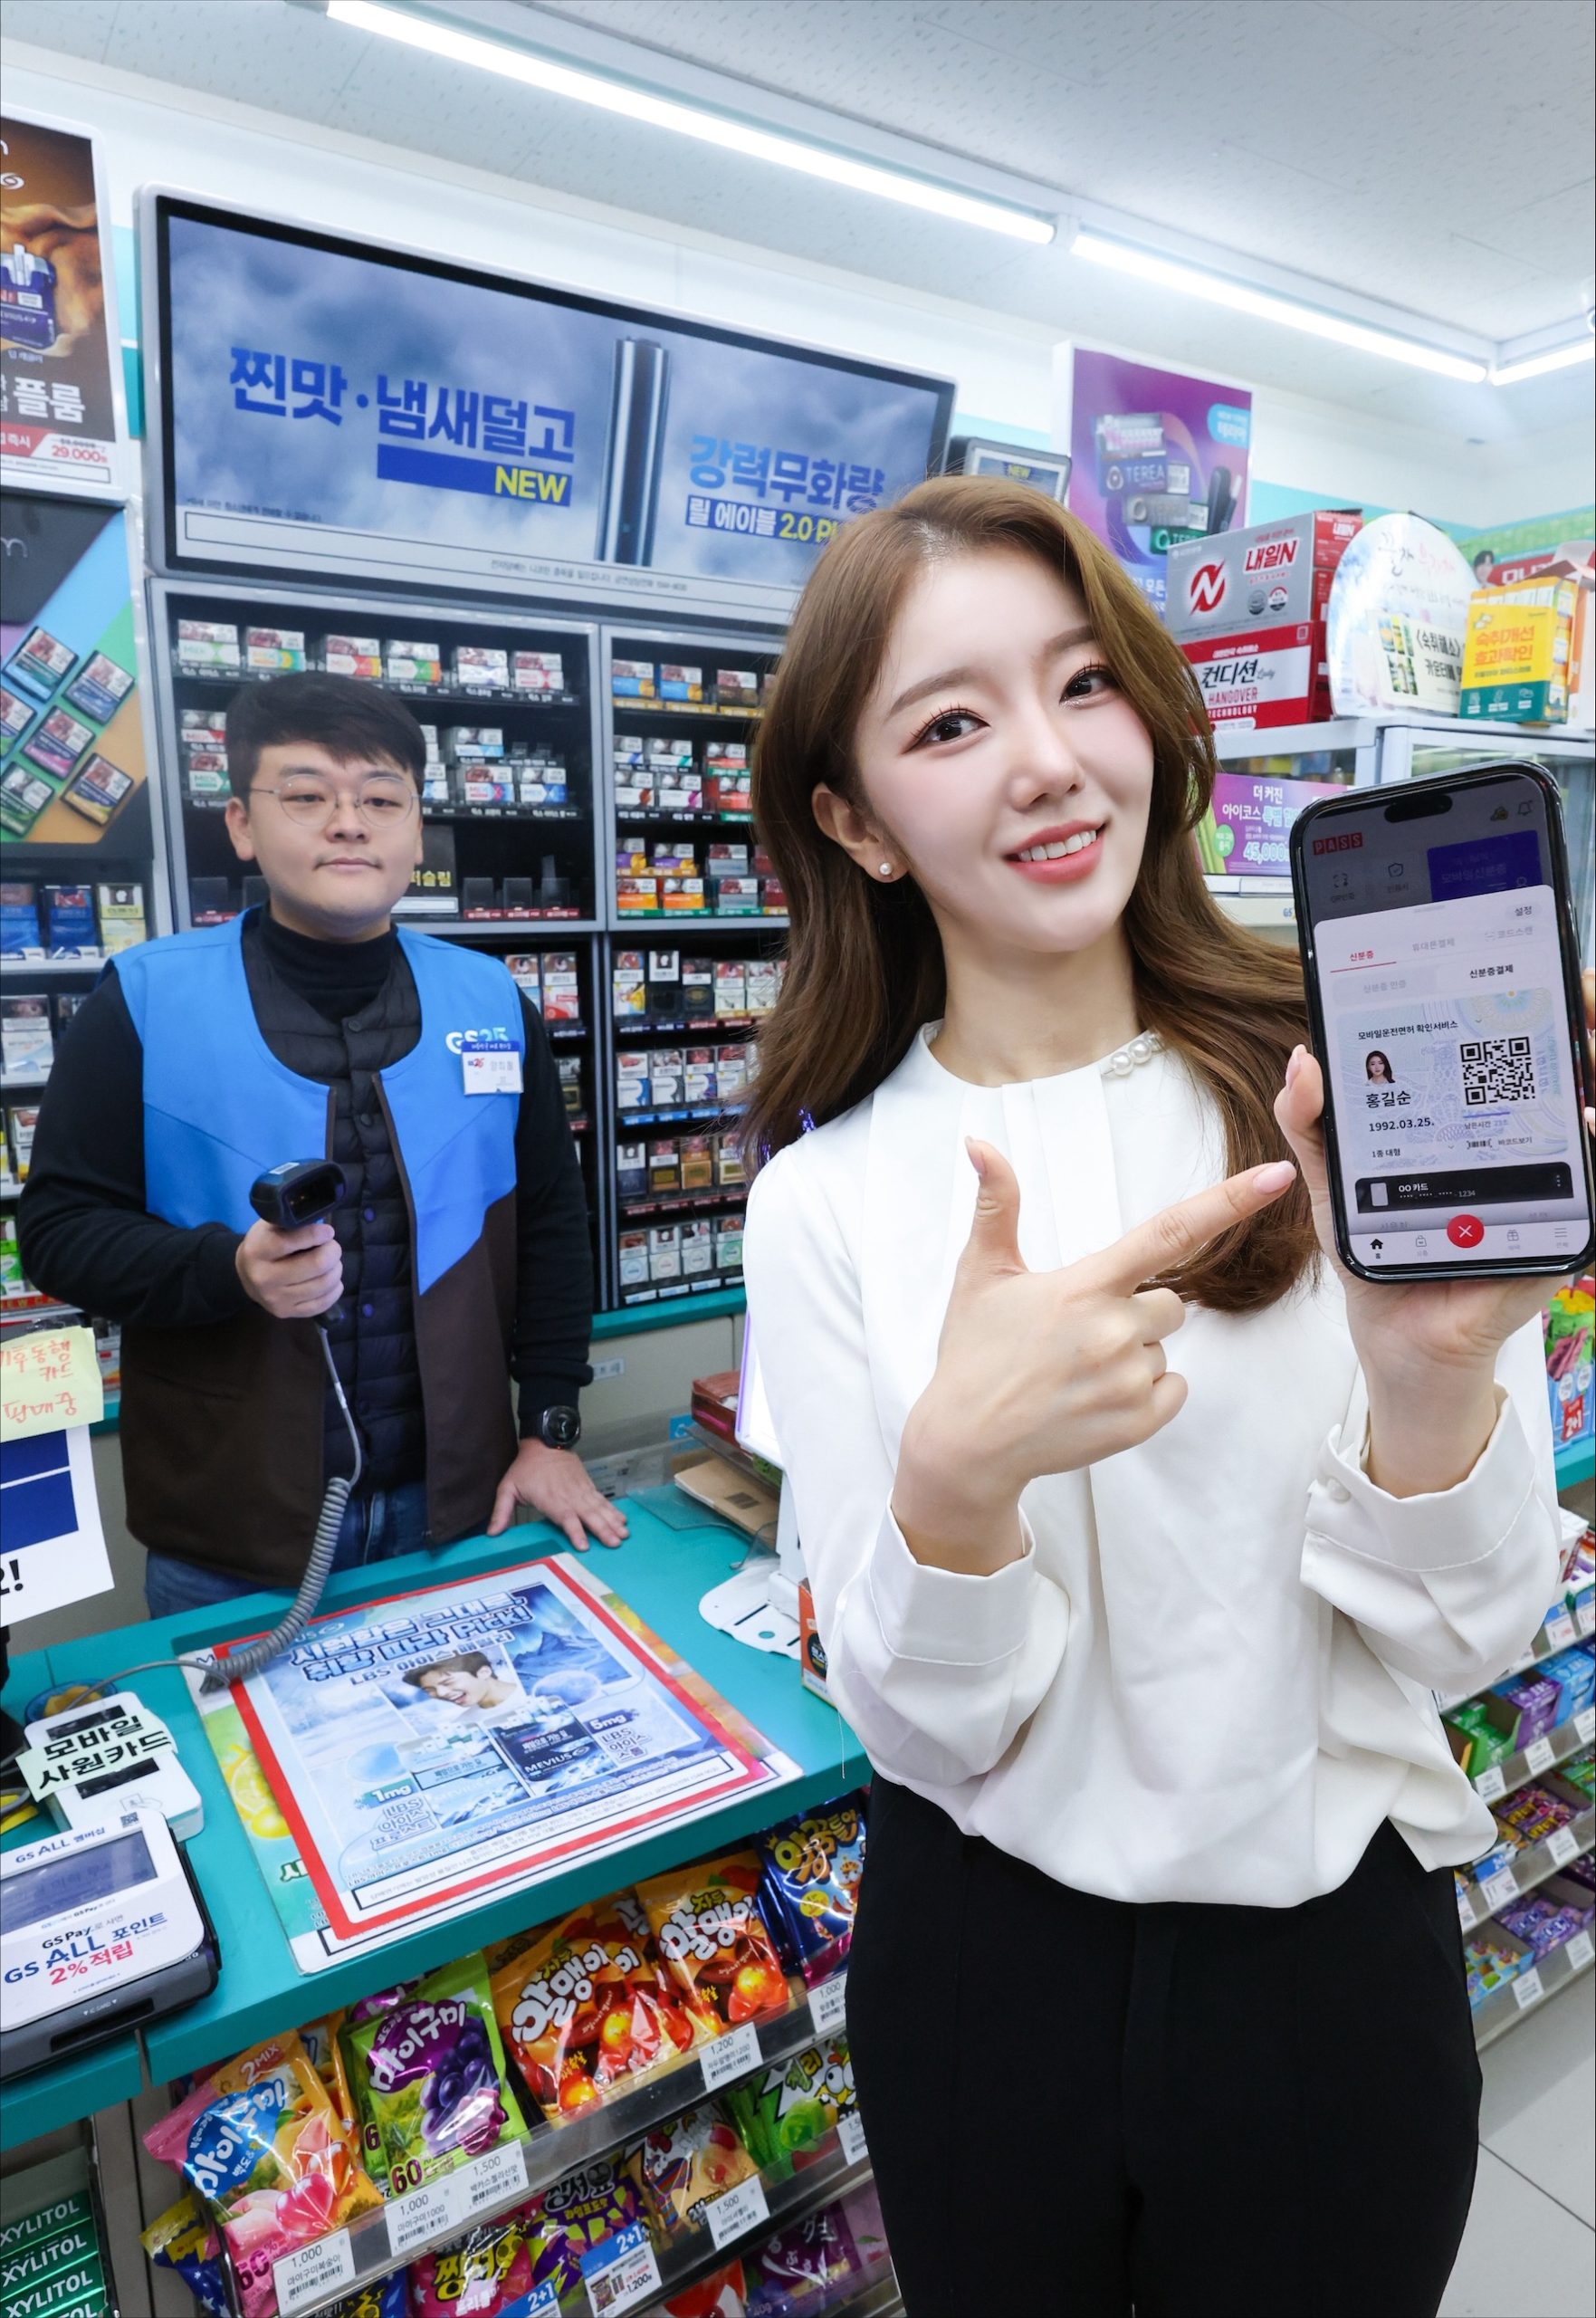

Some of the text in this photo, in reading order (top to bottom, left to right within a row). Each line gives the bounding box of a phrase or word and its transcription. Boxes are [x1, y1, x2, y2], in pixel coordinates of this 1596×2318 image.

[14, 377, 86, 424] 플룸
[494, 465, 568, 503] NEW
[690, 435, 885, 514] 강력무화량
[1008, 464, 1031, 479] NEW
[1125, 464, 1165, 481] TEREA
[689, 498, 712, 527] 릴
[715, 503, 777, 537] 에이블
[779, 512, 813, 541] 2.0
[1245, 540, 1298, 572] 내일N
[1476, 626, 1535, 647] 숙취개선
[1201, 659, 1258, 689] 컨디션
[1209, 686, 1258, 705] HANGOVER
[1253, 784, 1284, 805] 더 커진
[1222, 802, 1262, 821] 아이코스
[1314, 833, 1363, 856] PASS
[1514, 905, 1534, 917] 설정
[1349, 950, 1374, 963] 신분증
[1469, 963, 1515, 980] 신분증결제
[1358, 1020, 1459, 1040] 모바일운전면허 확인서비스
[1365, 1090, 1412, 1110] 홍길순
[1368, 1117, 1436, 1133] 1992.03.25.
[1371, 1147, 1402, 1159] 1종 대형
[40, 1362, 73, 1383] 카드
[291, 1617, 418, 1668] 시원함은
[303, 1649, 375, 1682] 취향
[451, 1604, 536, 1642] Pick!
[349, 1666, 392, 1686] LBS
[397, 1648, 456, 1672] 아이스
[589, 1712, 627, 1731] 5mg
[44, 1714, 145, 1762] 모바일
[601, 1727, 633, 1744] LBS
[39, 1729, 174, 1791] 사원카드
[523, 1752, 573, 1774] MEVIUS
[371, 1779, 414, 1805] 1mg
[378, 1809, 431, 1832] 아이스
[15, 1826, 107, 1864] GS ALL 멤버십
[659, 1895, 756, 1963] 알맹이
[5, 1960, 41, 1984] GS
[46, 1934, 107, 1970] ALL
[112, 1911, 168, 1942] 포인트
[49, 1959, 89, 1986] 2%
[89, 1940, 135, 1967] 적립
[511, 1942, 610, 2043] 알맹이
[368, 1999, 466, 2093] 마이구미
[711, 2036, 734, 2055] 1,200
[240, 2043, 281, 2085] 2MIX
[194, 2077, 286, 2198] 마이구미
[473, 2155, 502, 2177] 1,500
[399, 2193, 430, 2217] 1,000
[716, 2194, 741, 2216] 1,500
[0, 2198, 80, 2247] XYLITOL
[616, 2224, 644, 2255] 2+1
[2, 2233, 87, 2288] XYLITOL
[291, 2244, 323, 2268] 1,000
[5, 2269, 94, 2318] XYLITOL
[527, 2281, 555, 2313] 2+1
